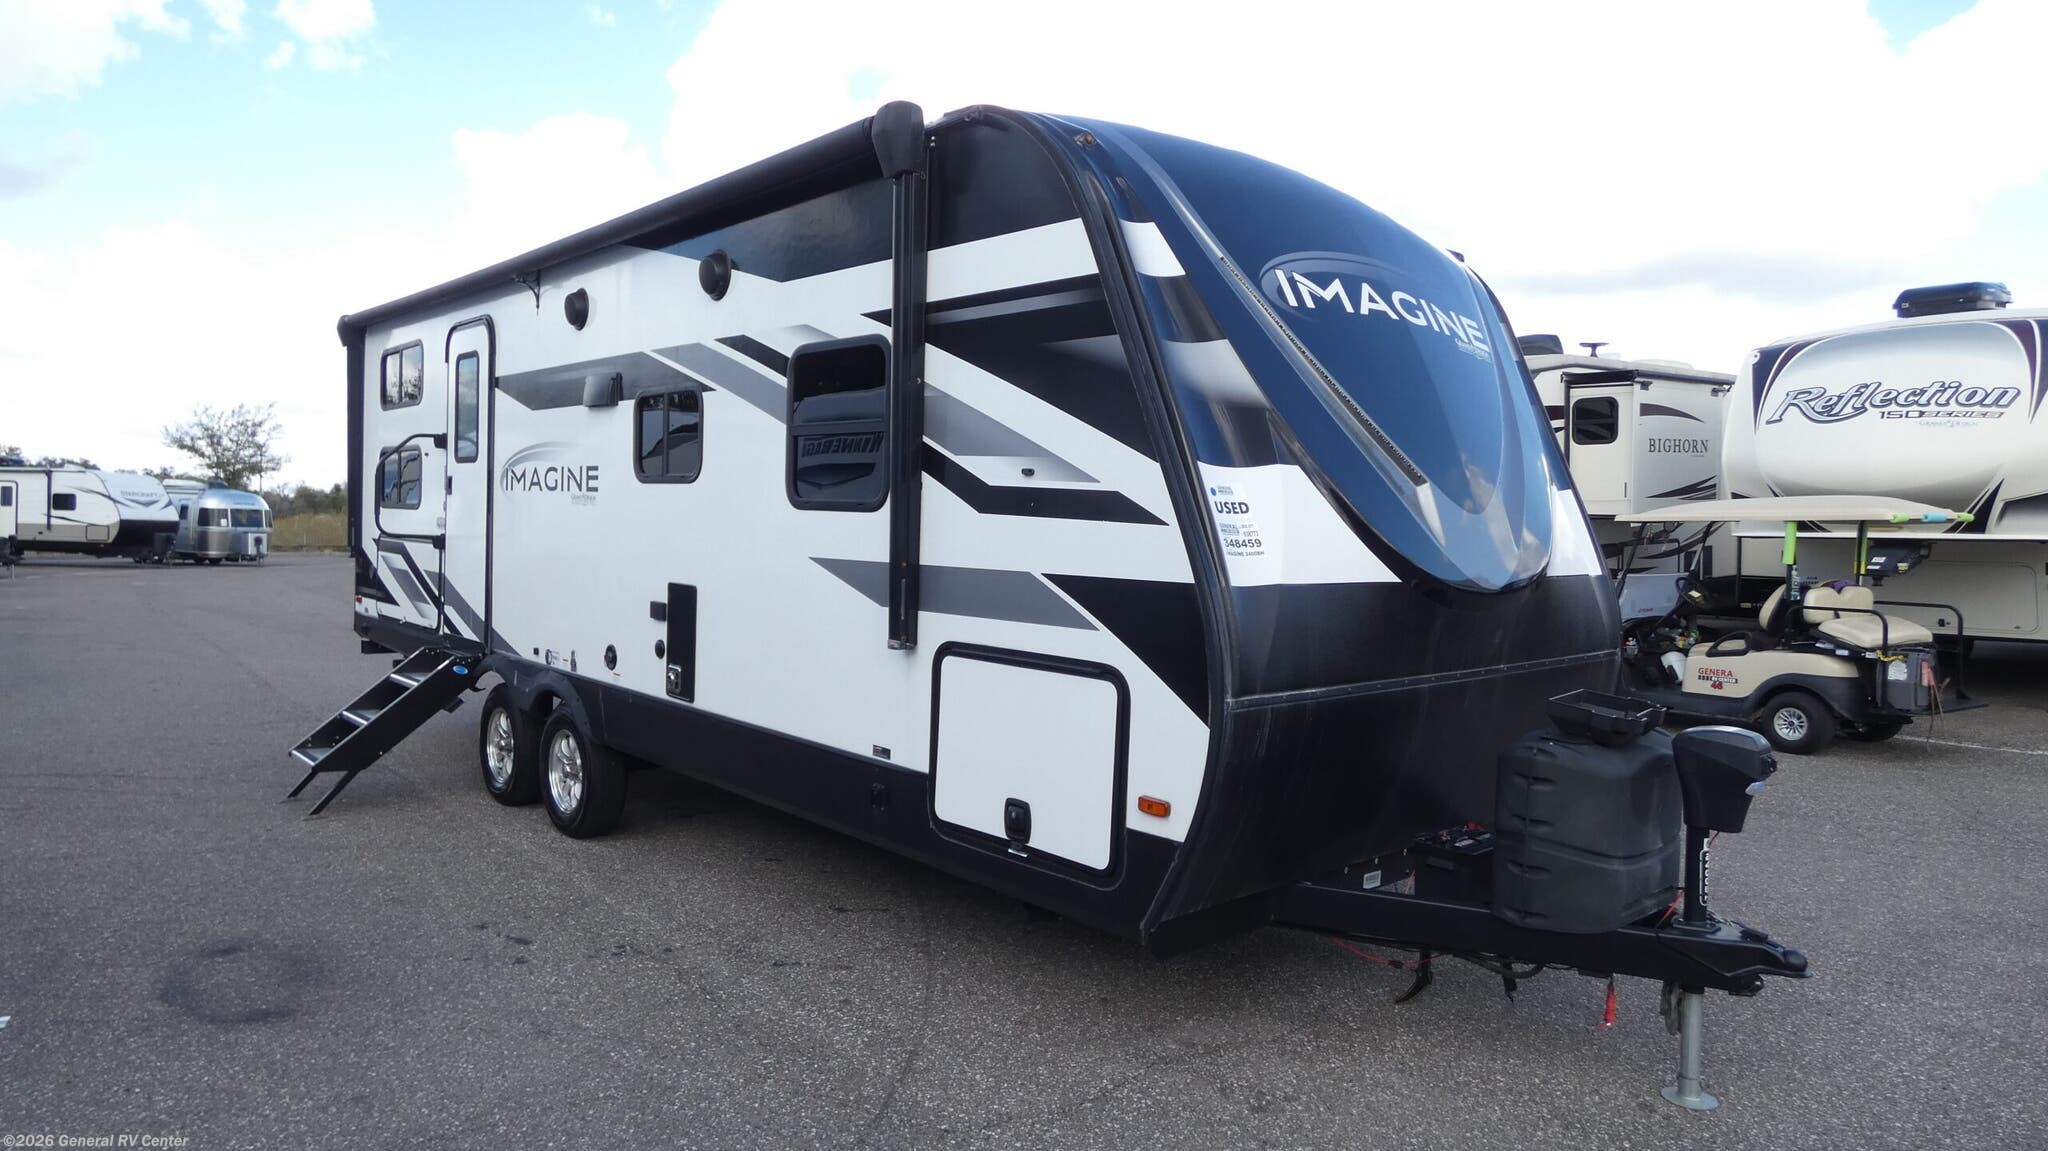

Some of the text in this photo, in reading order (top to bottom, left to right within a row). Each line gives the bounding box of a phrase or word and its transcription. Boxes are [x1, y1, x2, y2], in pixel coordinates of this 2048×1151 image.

[1274, 269, 1489, 352] IMAGINE
[1765, 381, 2021, 425] Reflection
[1648, 438, 1709, 454] BIGHORN
[505, 466, 599, 493] IMAGINE
[1214, 501, 1250, 515] USED
[1224, 538, 1262, 549] 348459
[1698, 667, 1733, 677] GENERA
